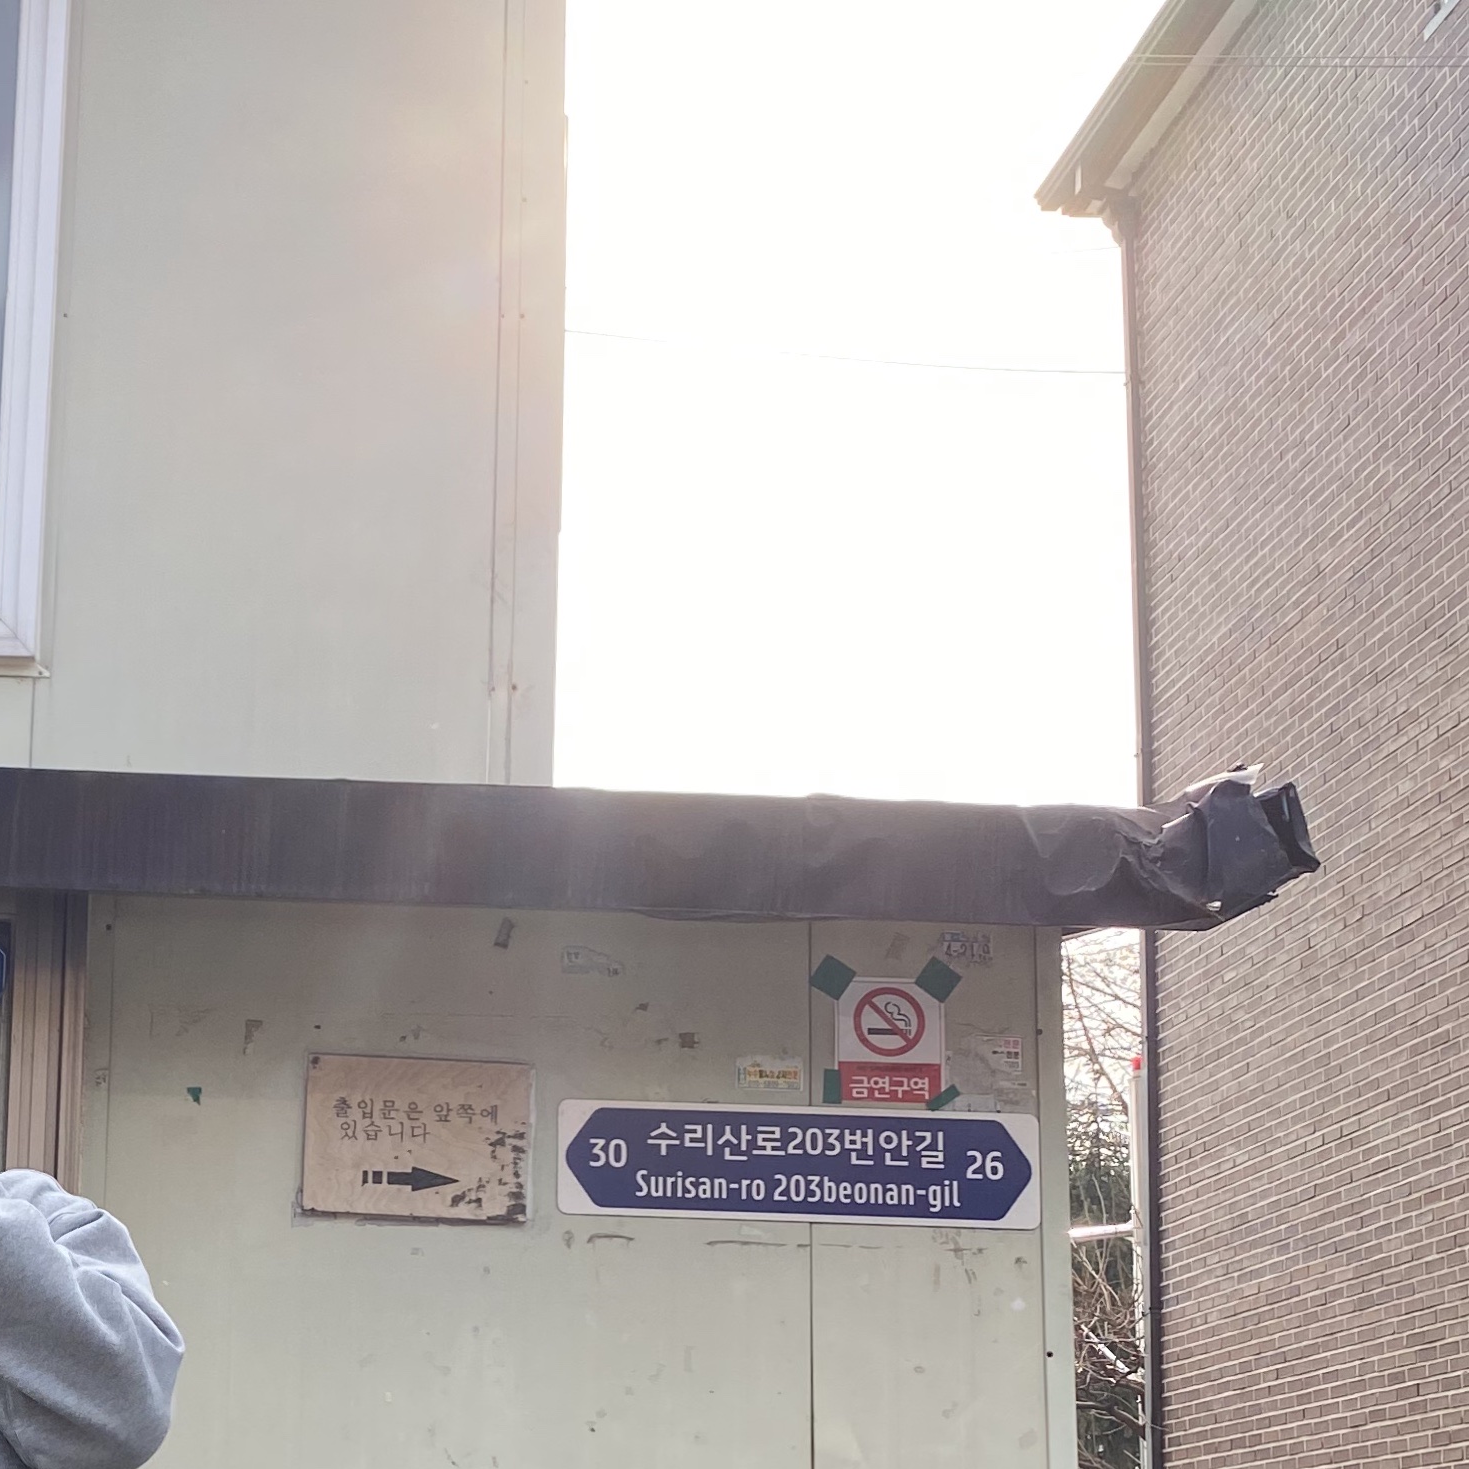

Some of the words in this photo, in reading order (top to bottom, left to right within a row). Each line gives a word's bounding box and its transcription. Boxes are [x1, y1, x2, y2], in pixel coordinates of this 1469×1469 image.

[848, 1075, 930, 1101] 금연구역
[333, 1096, 424, 1122] 출입문은
[433, 1101, 499, 1126] 앞쪽에
[340, 1119, 431, 1144] 있습니다
[589, 1138, 628, 1169] 30
[646, 1121, 946, 1170] 수리산로203번안길
[965, 1150, 1005, 1181] 26
[635, 1169, 767, 1202] Surisan-ro
[772, 1173, 962, 1213] 203beonan-gil
